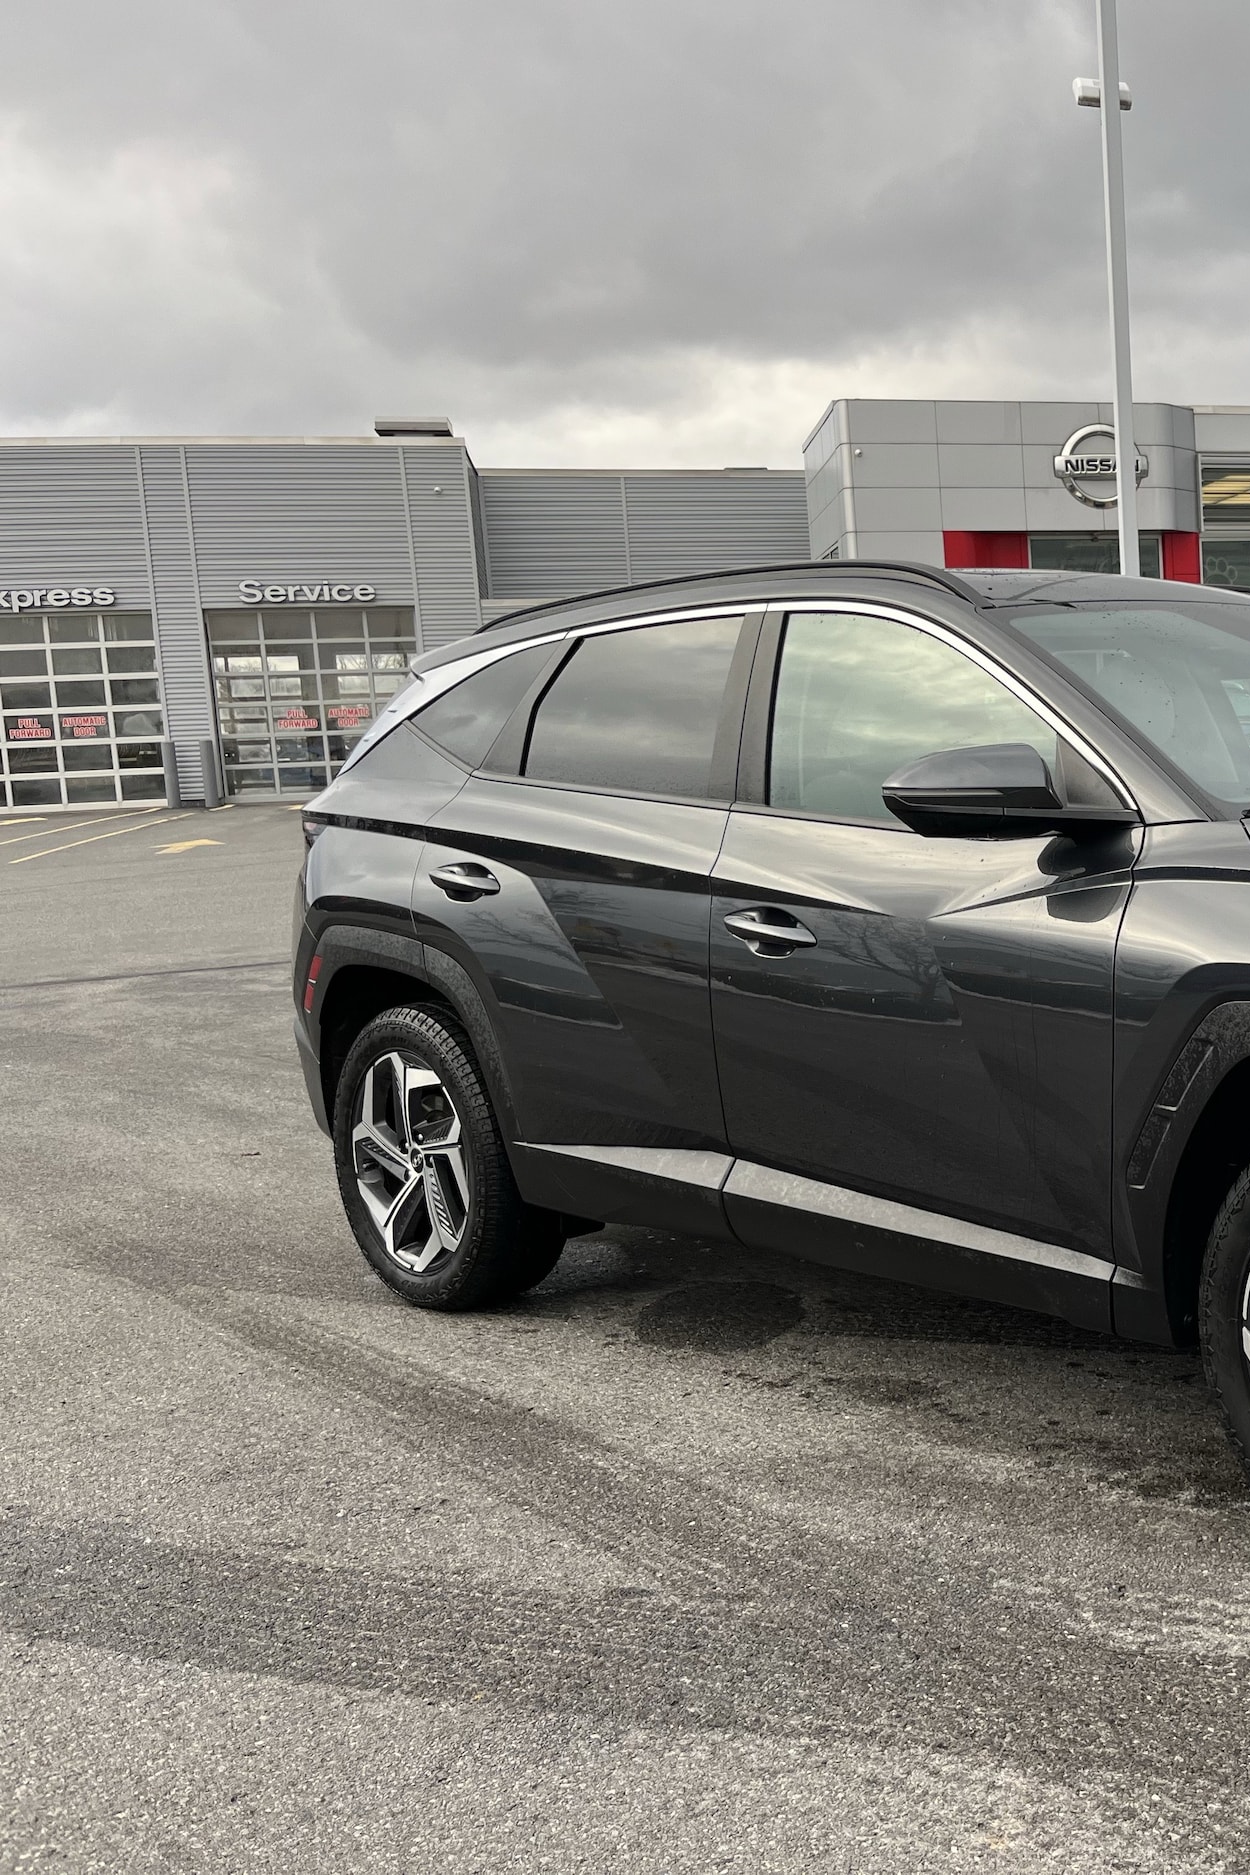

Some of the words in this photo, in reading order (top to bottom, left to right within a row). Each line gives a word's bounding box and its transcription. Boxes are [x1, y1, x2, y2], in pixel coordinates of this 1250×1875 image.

[1064, 458, 1140, 474] NISS
[238, 579, 376, 604] Service
[286, 709, 308, 719] PULL
[328, 707, 370, 718] AUTOMATIC
[18, 718, 41, 729] PULL
[62, 716, 106, 727] AUTOMATIC
[278, 719, 319, 729] FORWARD
[338, 718, 360, 728] DOOR
[9, 728, 51, 739] FORWARD
[73, 727, 97, 737] DOOR
